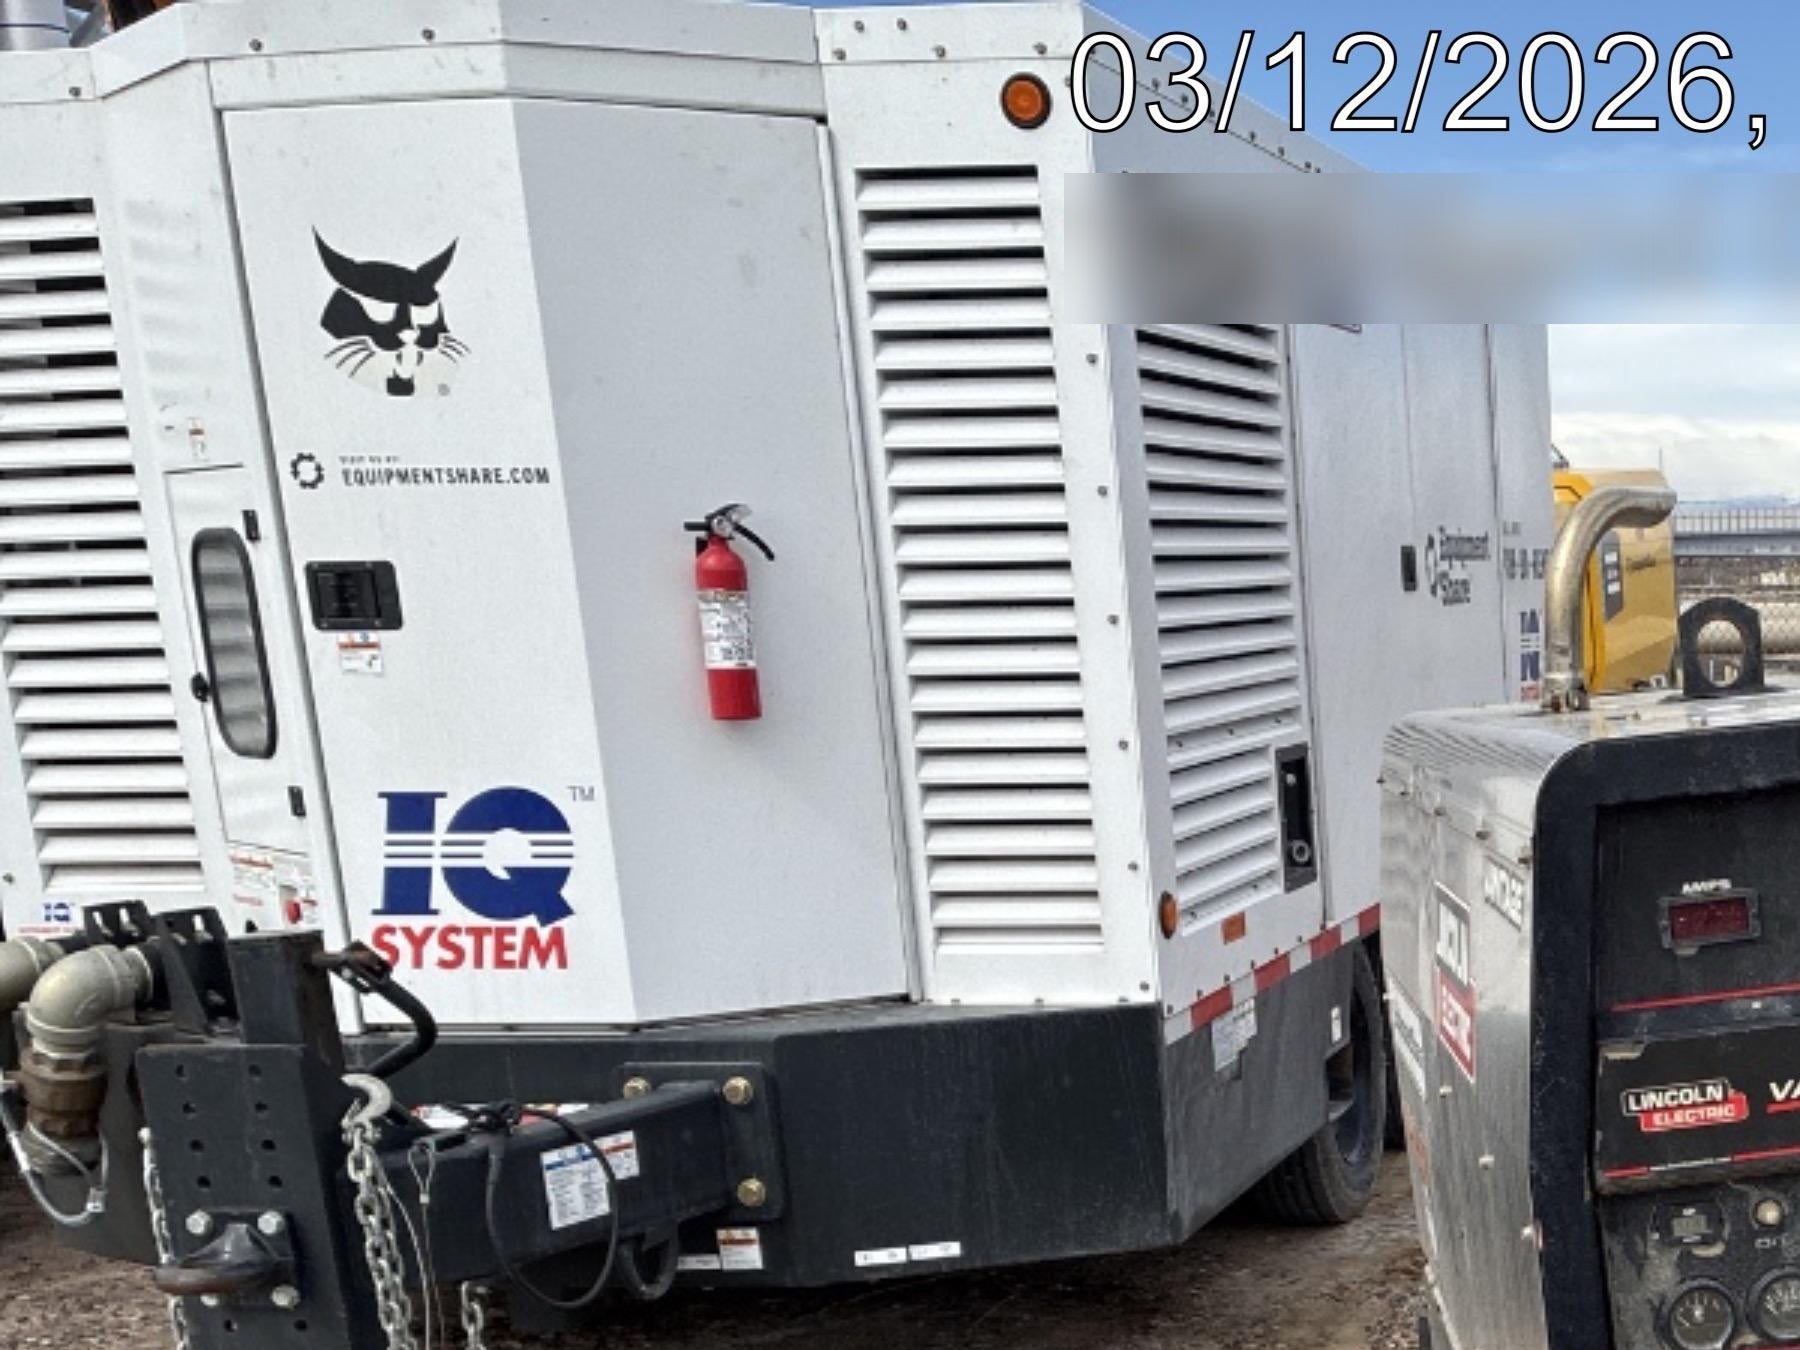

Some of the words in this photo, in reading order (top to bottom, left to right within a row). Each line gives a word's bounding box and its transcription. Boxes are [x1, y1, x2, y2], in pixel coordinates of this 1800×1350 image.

[342, 466, 551, 486] EQUIPMENTSHARE.COM
[371, 785, 576, 928] IQ
[371, 923, 569, 970] SYSTEM
[1626, 1084, 1724, 1114] LINCOLN
[1653, 1103, 1737, 1128] ELECTRIC
